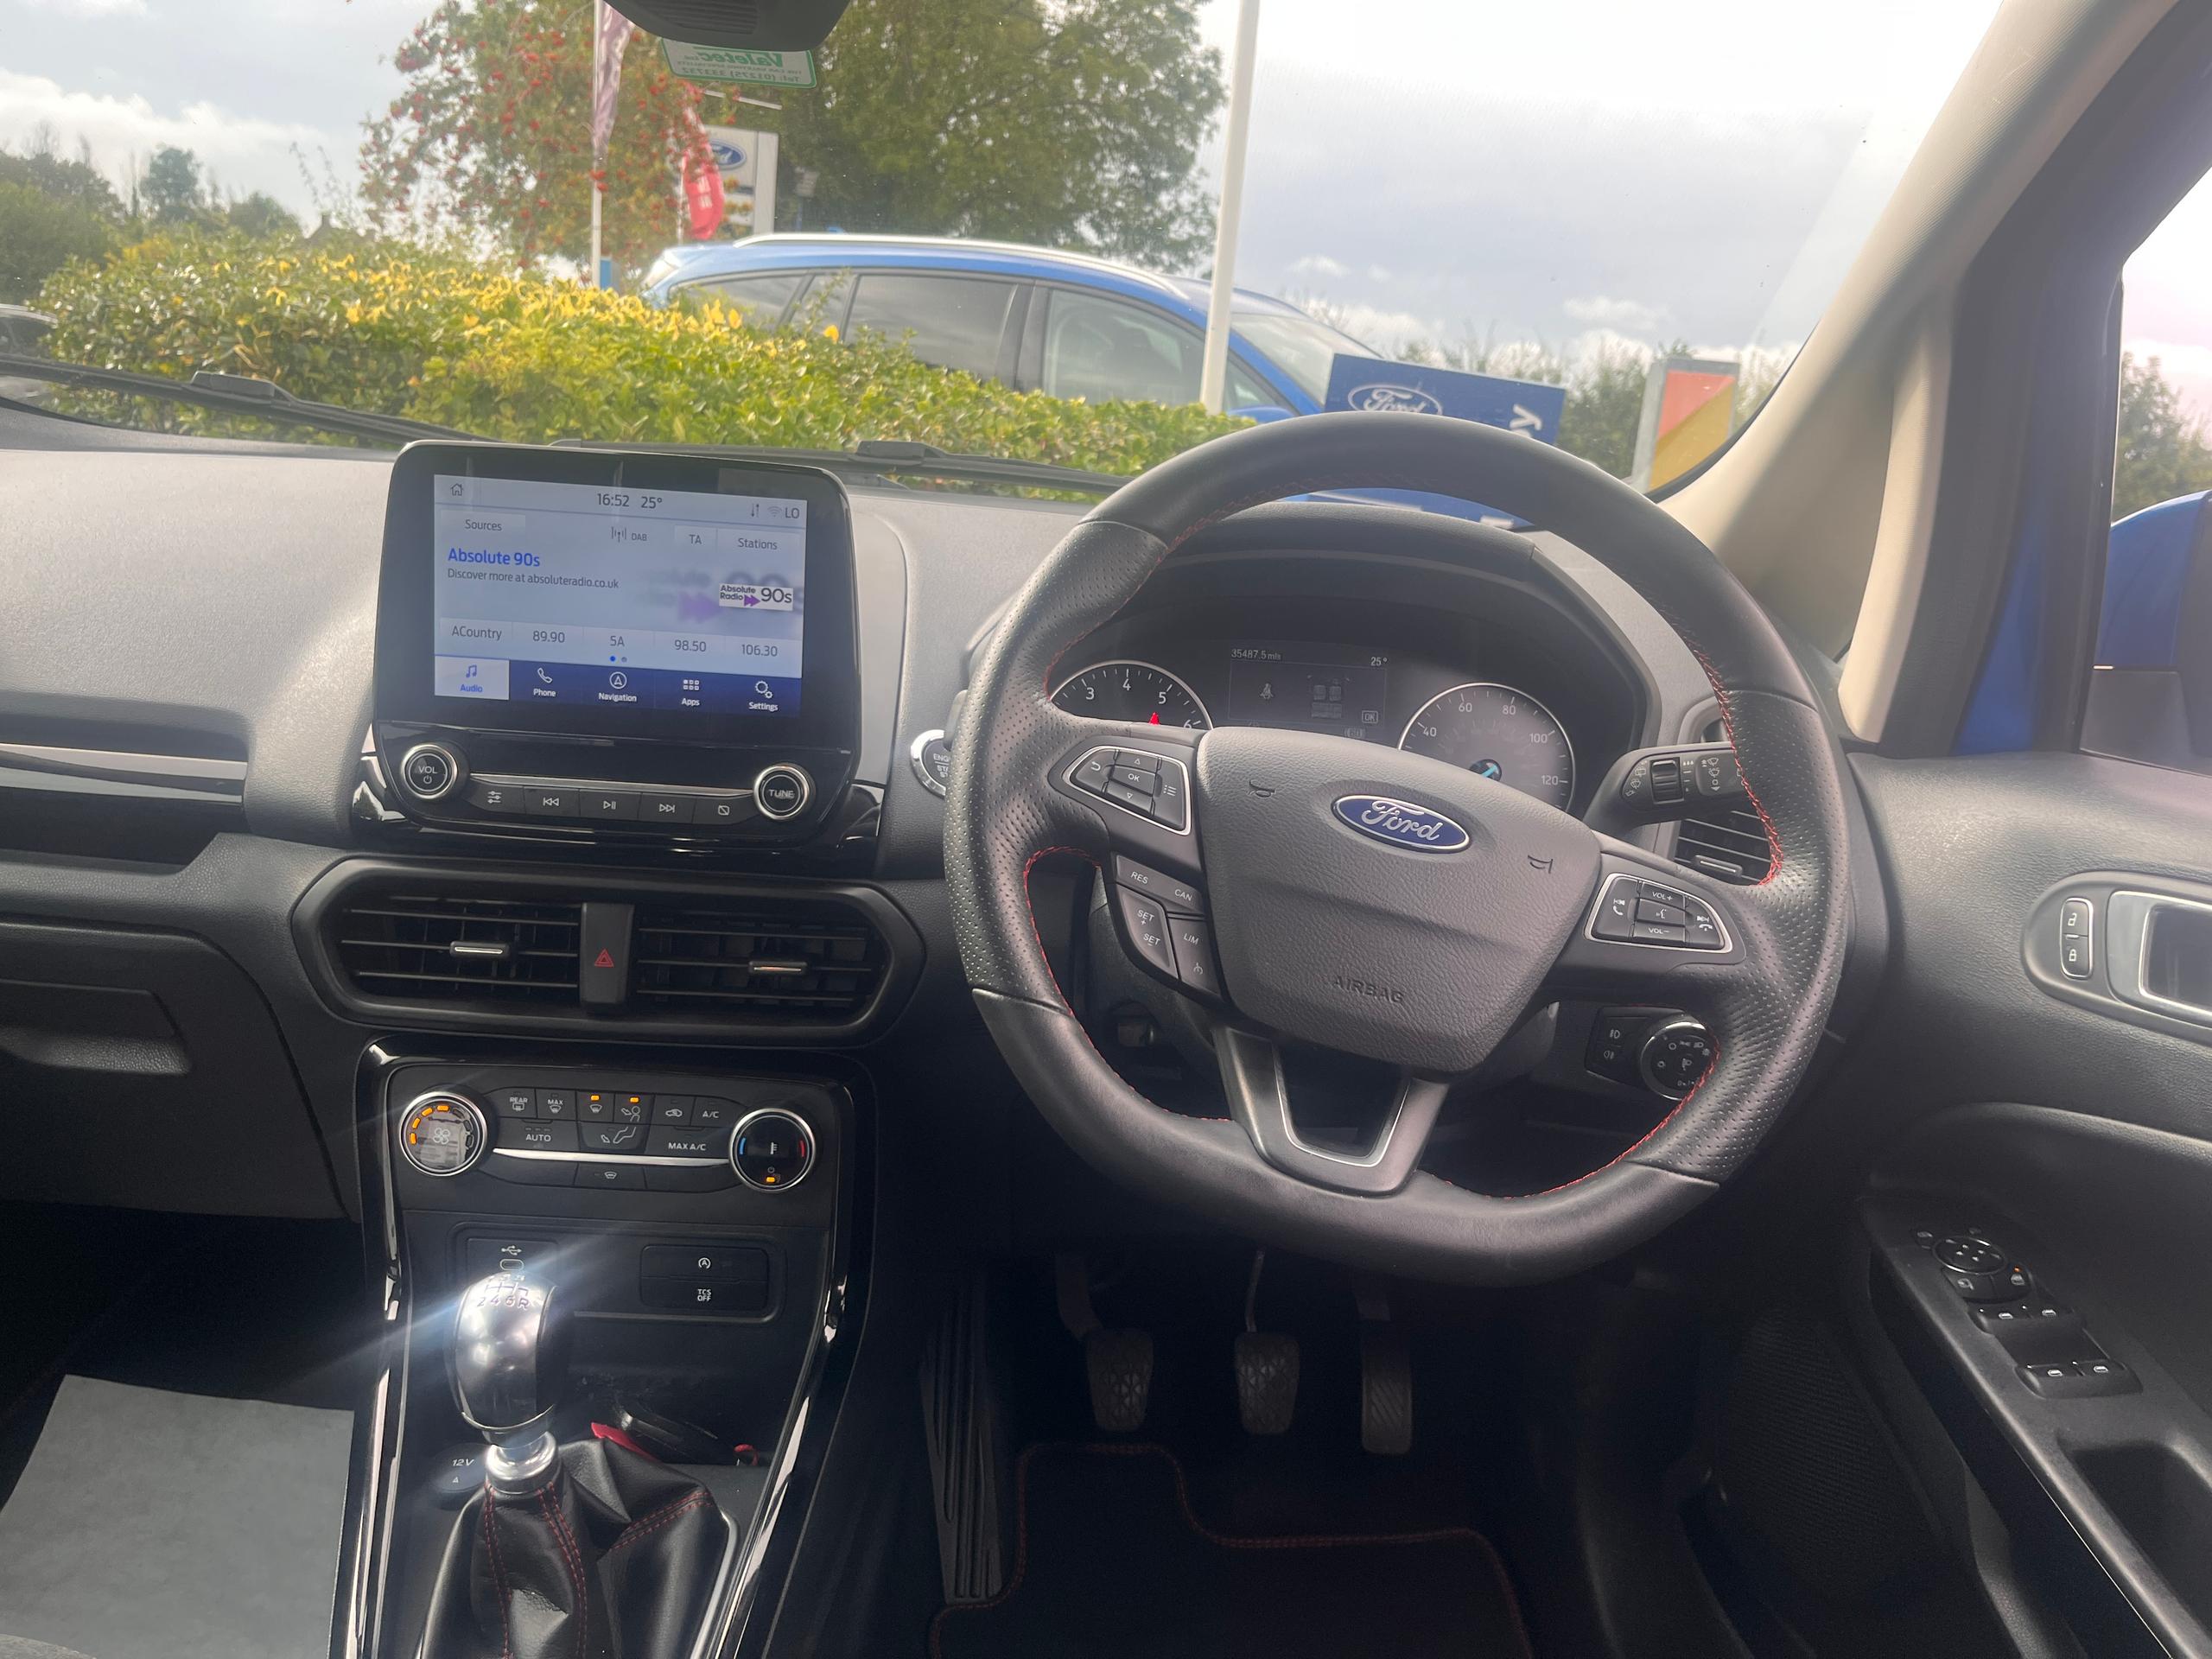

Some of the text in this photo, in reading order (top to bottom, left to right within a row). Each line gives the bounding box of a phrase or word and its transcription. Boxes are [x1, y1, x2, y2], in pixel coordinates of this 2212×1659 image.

[597, 493, 663, 509] 16:52 25°
[785, 507, 800, 518] LO
[465, 519, 502, 531] Sources
[631, 533, 647, 542] DAB
[689, 534, 702, 544] TA
[737, 537, 778, 550] Stations
[448, 548, 541, 567] Absolute 90s
[448, 568, 620, 588] Discover more at absoluteradio.co.uk
[720, 584, 756, 594] Absolute
[720, 592, 743, 601] Radio
[760, 588, 792, 603] 90s
[451, 625, 502, 641] ACountry
[532, 630, 565, 644] 89.90
[674, 639, 707, 652] 98.50
[741, 644, 778, 658] 106.30
[1230, 648, 1267, 660] 35487.5
[460, 683, 484, 693] Audio
[1122, 678, 1131, 690] 4
[533, 688, 556, 697] Phone
[598, 692, 638, 703] Navigation
[1085, 687, 1095, 700] 3
[1158, 691, 1166, 704] 5
[681, 697, 700, 707] Apps
[748, 702, 779, 712] Settings
[1458, 702, 1472, 713] 60
[1502, 704, 1516, 715] 80
[1423, 727, 1437, 737] 40
[1529, 733, 1548, 744] 100
[417, 766, 438, 774] VOL
[1128, 773, 1141, 782] OK
[1541, 775, 1559, 785] 120
[768, 789, 795, 799] TUNE
[1361, 800, 1443, 842] Ford
[1130, 871, 1149, 885] RES
[1174, 889, 1192, 901] CAN
[1137, 909, 1155, 921] SET
[1143, 932, 1161, 945] SET
[1183, 933, 1199, 945] LIM
[1332, 976, 1404, 1003] AIRBAG
[702, 1110, 720, 1119] A/C
[518, 1297, 530, 1310] R
[452, 1458, 475, 1466] 12V
